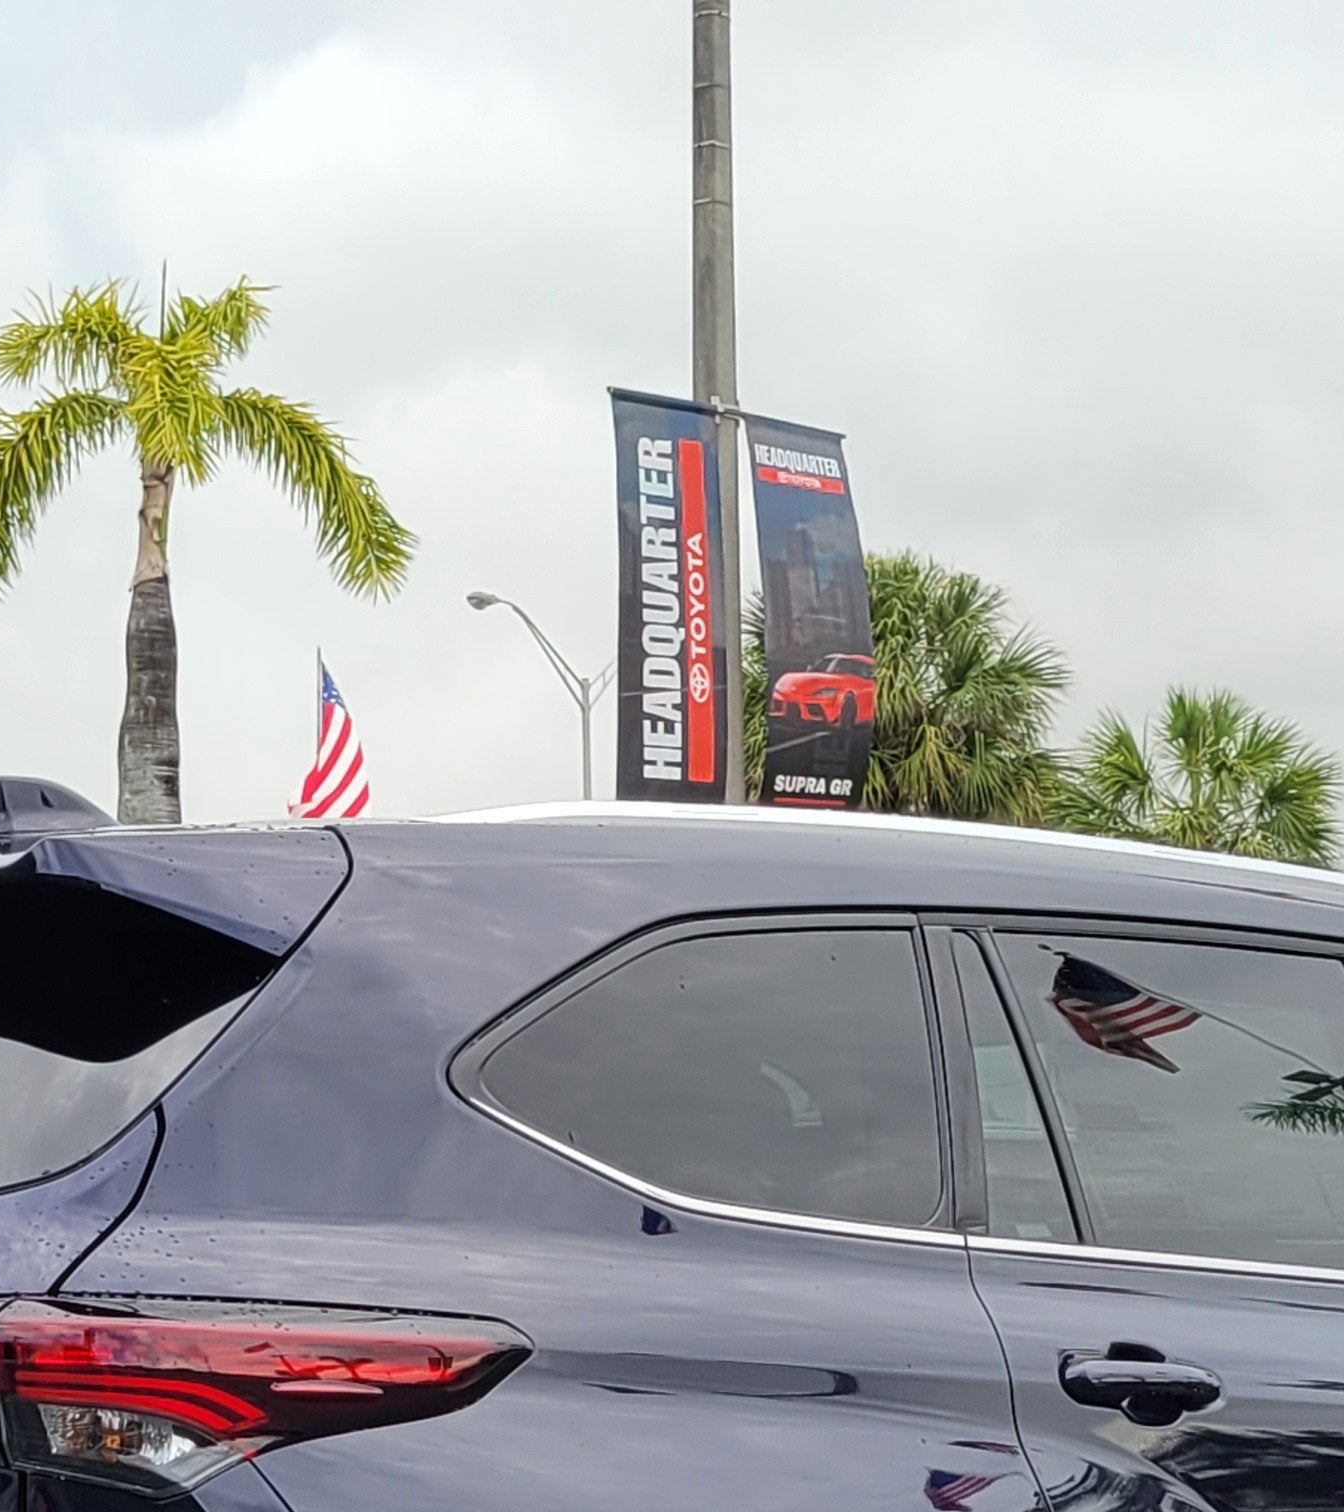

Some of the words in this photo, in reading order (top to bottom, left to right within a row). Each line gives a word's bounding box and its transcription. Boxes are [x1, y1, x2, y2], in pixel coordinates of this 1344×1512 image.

[754, 443, 842, 478] HEADQUARTER
[637, 437, 686, 781] HEADQUARTER
[687, 533, 708, 659] TOYOTA
[773, 775, 826, 795] SUPRA
[829, 778, 852, 797] GR
